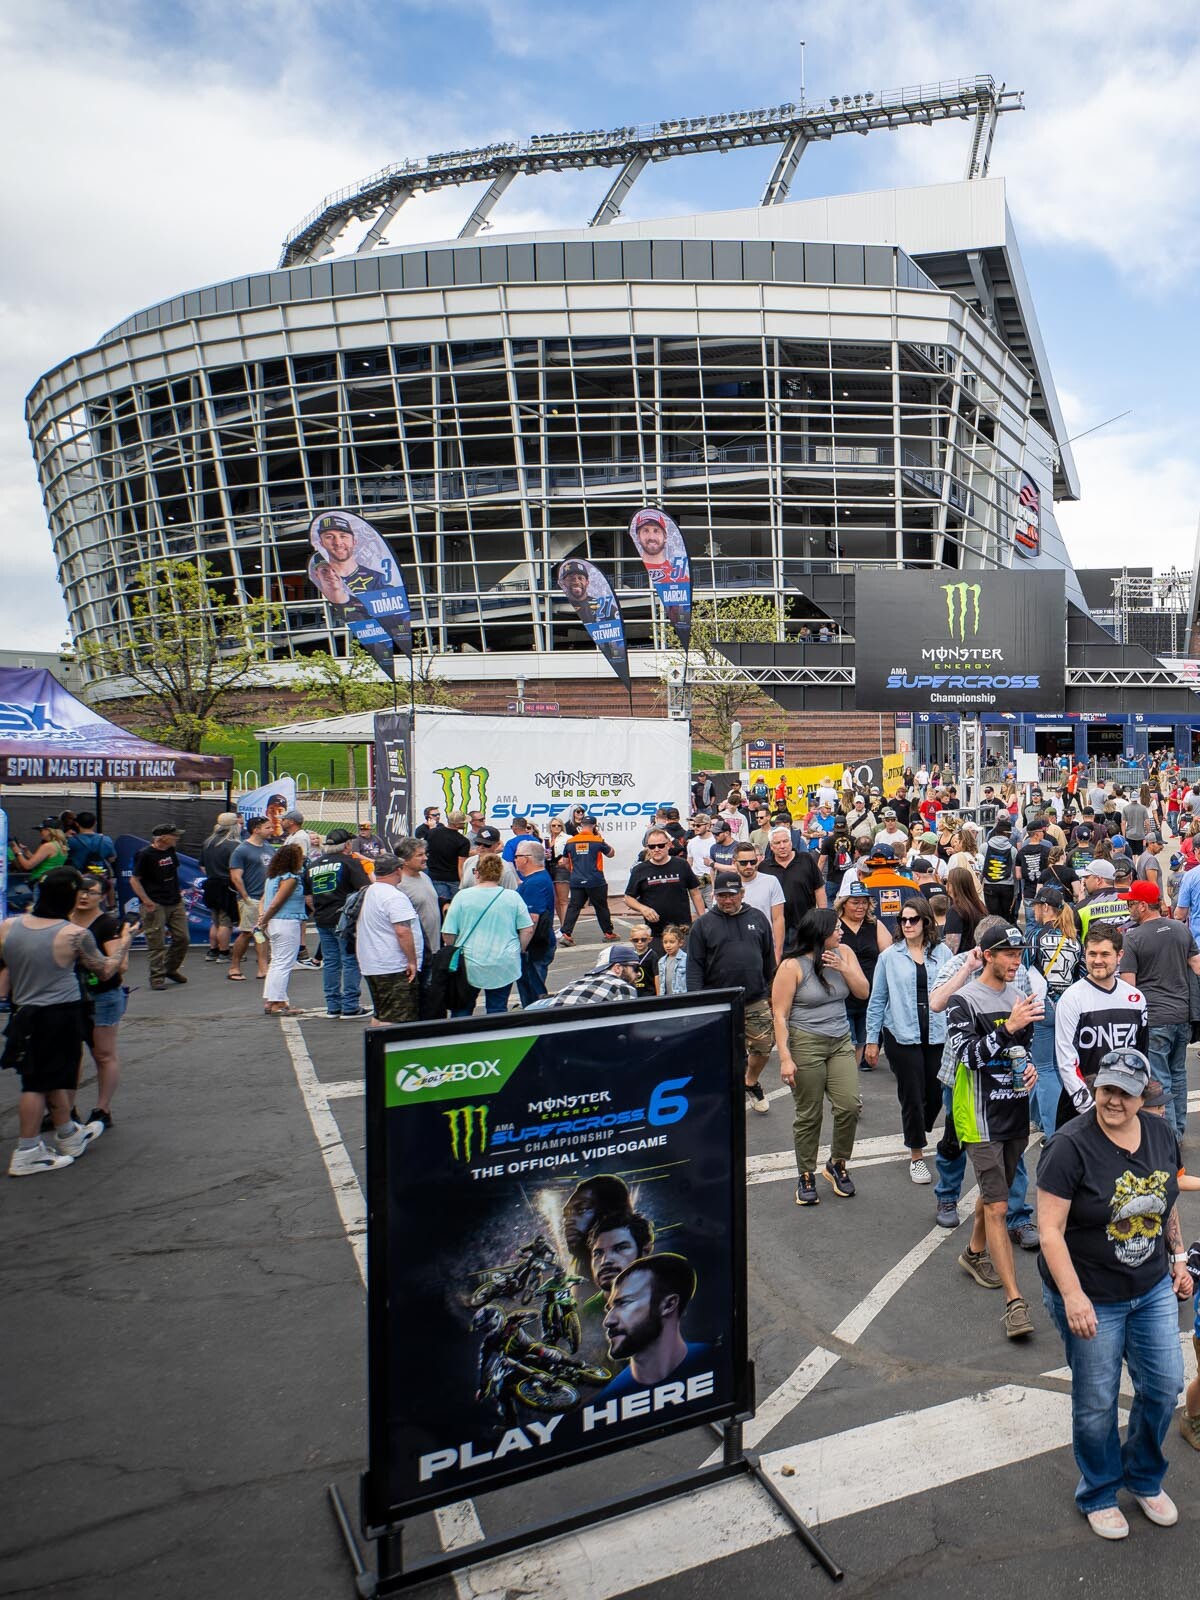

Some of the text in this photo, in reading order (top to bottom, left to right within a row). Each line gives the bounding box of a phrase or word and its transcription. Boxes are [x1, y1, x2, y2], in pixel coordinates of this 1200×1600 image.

[381, 559, 392, 584] 3
[663, 590, 688, 602] BARCIA
[370, 596, 404, 614] TOMAC
[597, 596, 614, 619] 27
[592, 627, 620, 640] STEWART
[921, 646, 1004, 662] MONSTER
[890, 668, 907, 676] AMA
[886, 675, 1040, 689] SUPERCROSS
[930, 693, 996, 704] Championship
[7, 758, 176, 777] SPIN MASTER TEST TRACK
[535, 770, 635, 788] MONSTER
[552, 789, 622, 798] ENERGY
[490, 802, 675, 818] SUPECROSS
[308, 862, 342, 876] TOMAC
[311, 871, 337, 895] 3
[1091, 906, 1108, 915] RMEC
[422, 1074, 445, 1084] BOLT
[434, 1059, 501, 1082] XBOX
[528, 1090, 611, 1114] MONSTER
[650, 1076, 693, 1126] 6
[541, 1106, 600, 1120] ENERGY
[490, 1108, 646, 1145] SUPERCROSS
[495, 1123, 515, 1131] AMA
[525, 1130, 614, 1153] CHAMPIONSHIP
[471, 1135, 667, 1180] THE OFFICIAL VIDEOGAME
[419, 1371, 714, 1482] PLAY HERE
